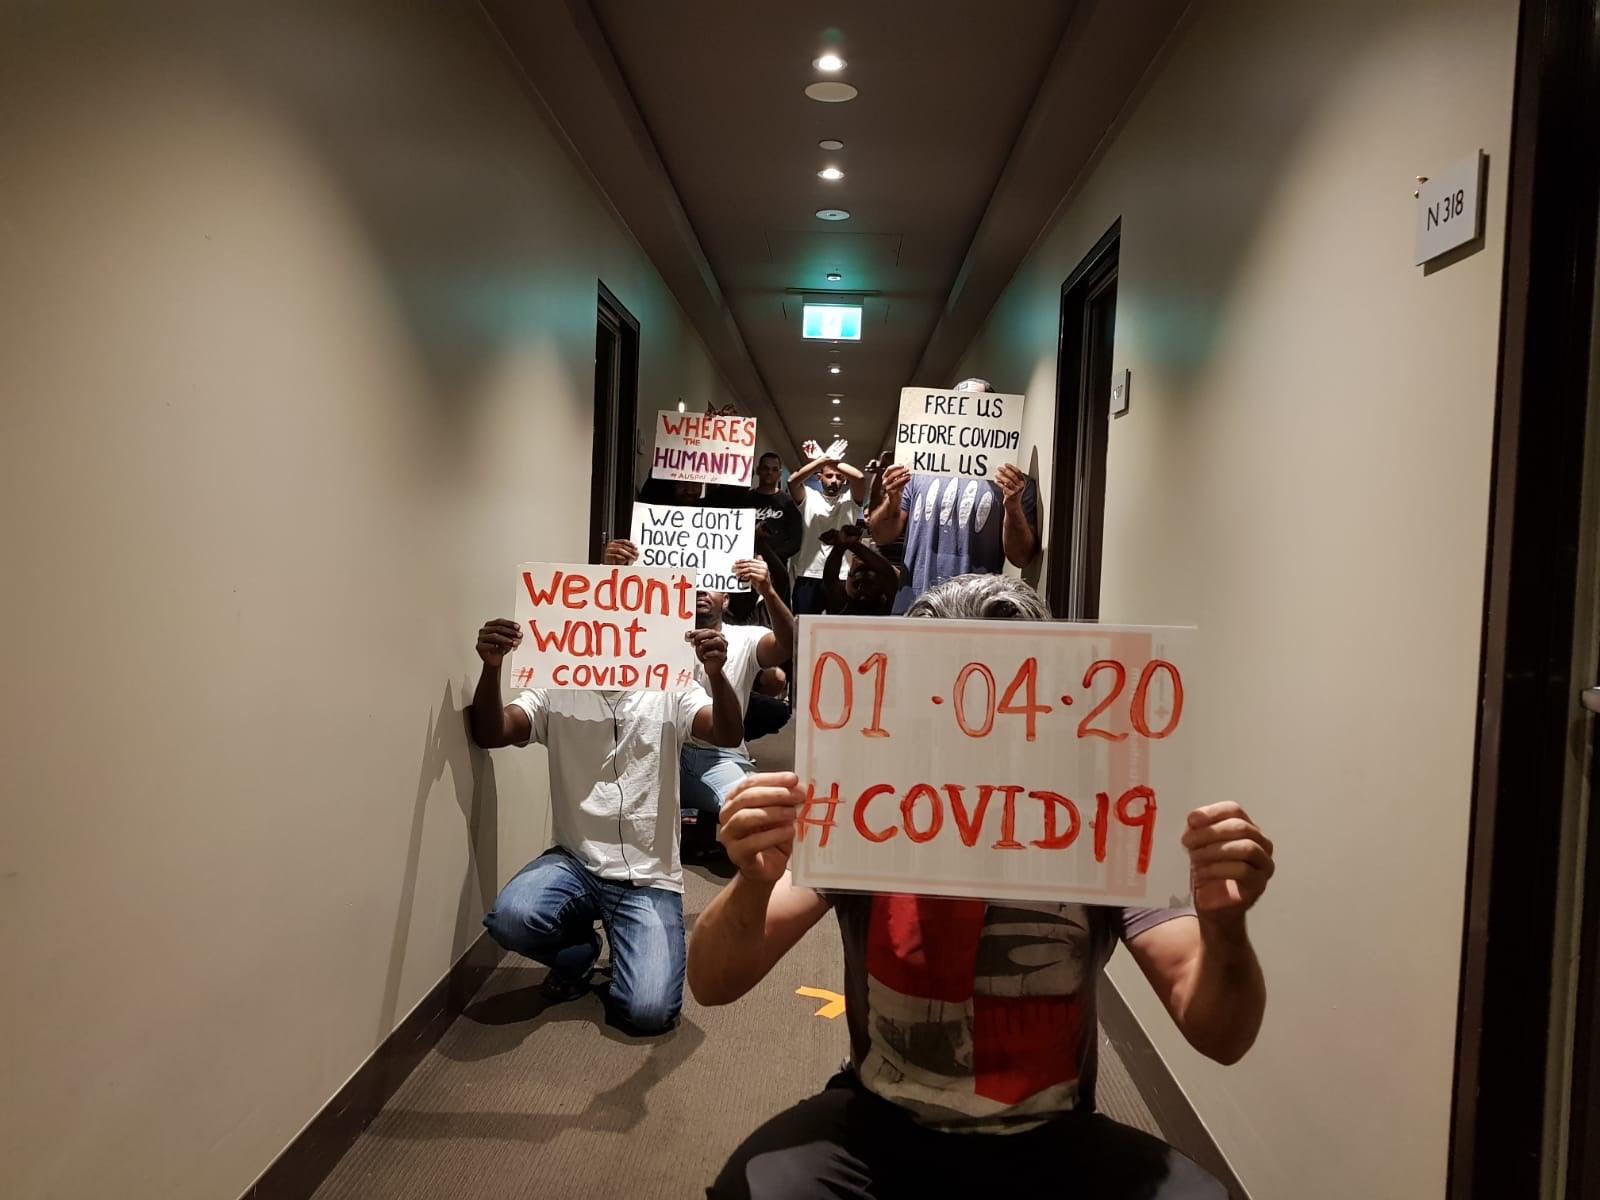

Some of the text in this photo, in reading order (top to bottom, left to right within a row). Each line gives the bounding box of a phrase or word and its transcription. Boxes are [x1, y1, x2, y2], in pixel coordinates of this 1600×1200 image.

[925, 395, 1004, 418] FREE US
[662, 415, 755, 447] WHERE'S
[683, 437, 701, 447] THE
[898, 423, 1020, 450] BEFORE COVID19
[913, 451, 988, 477] KILL US
[691, 507, 744, 531] don't
[640, 522, 739, 554] have any
[642, 548, 707, 569] social
